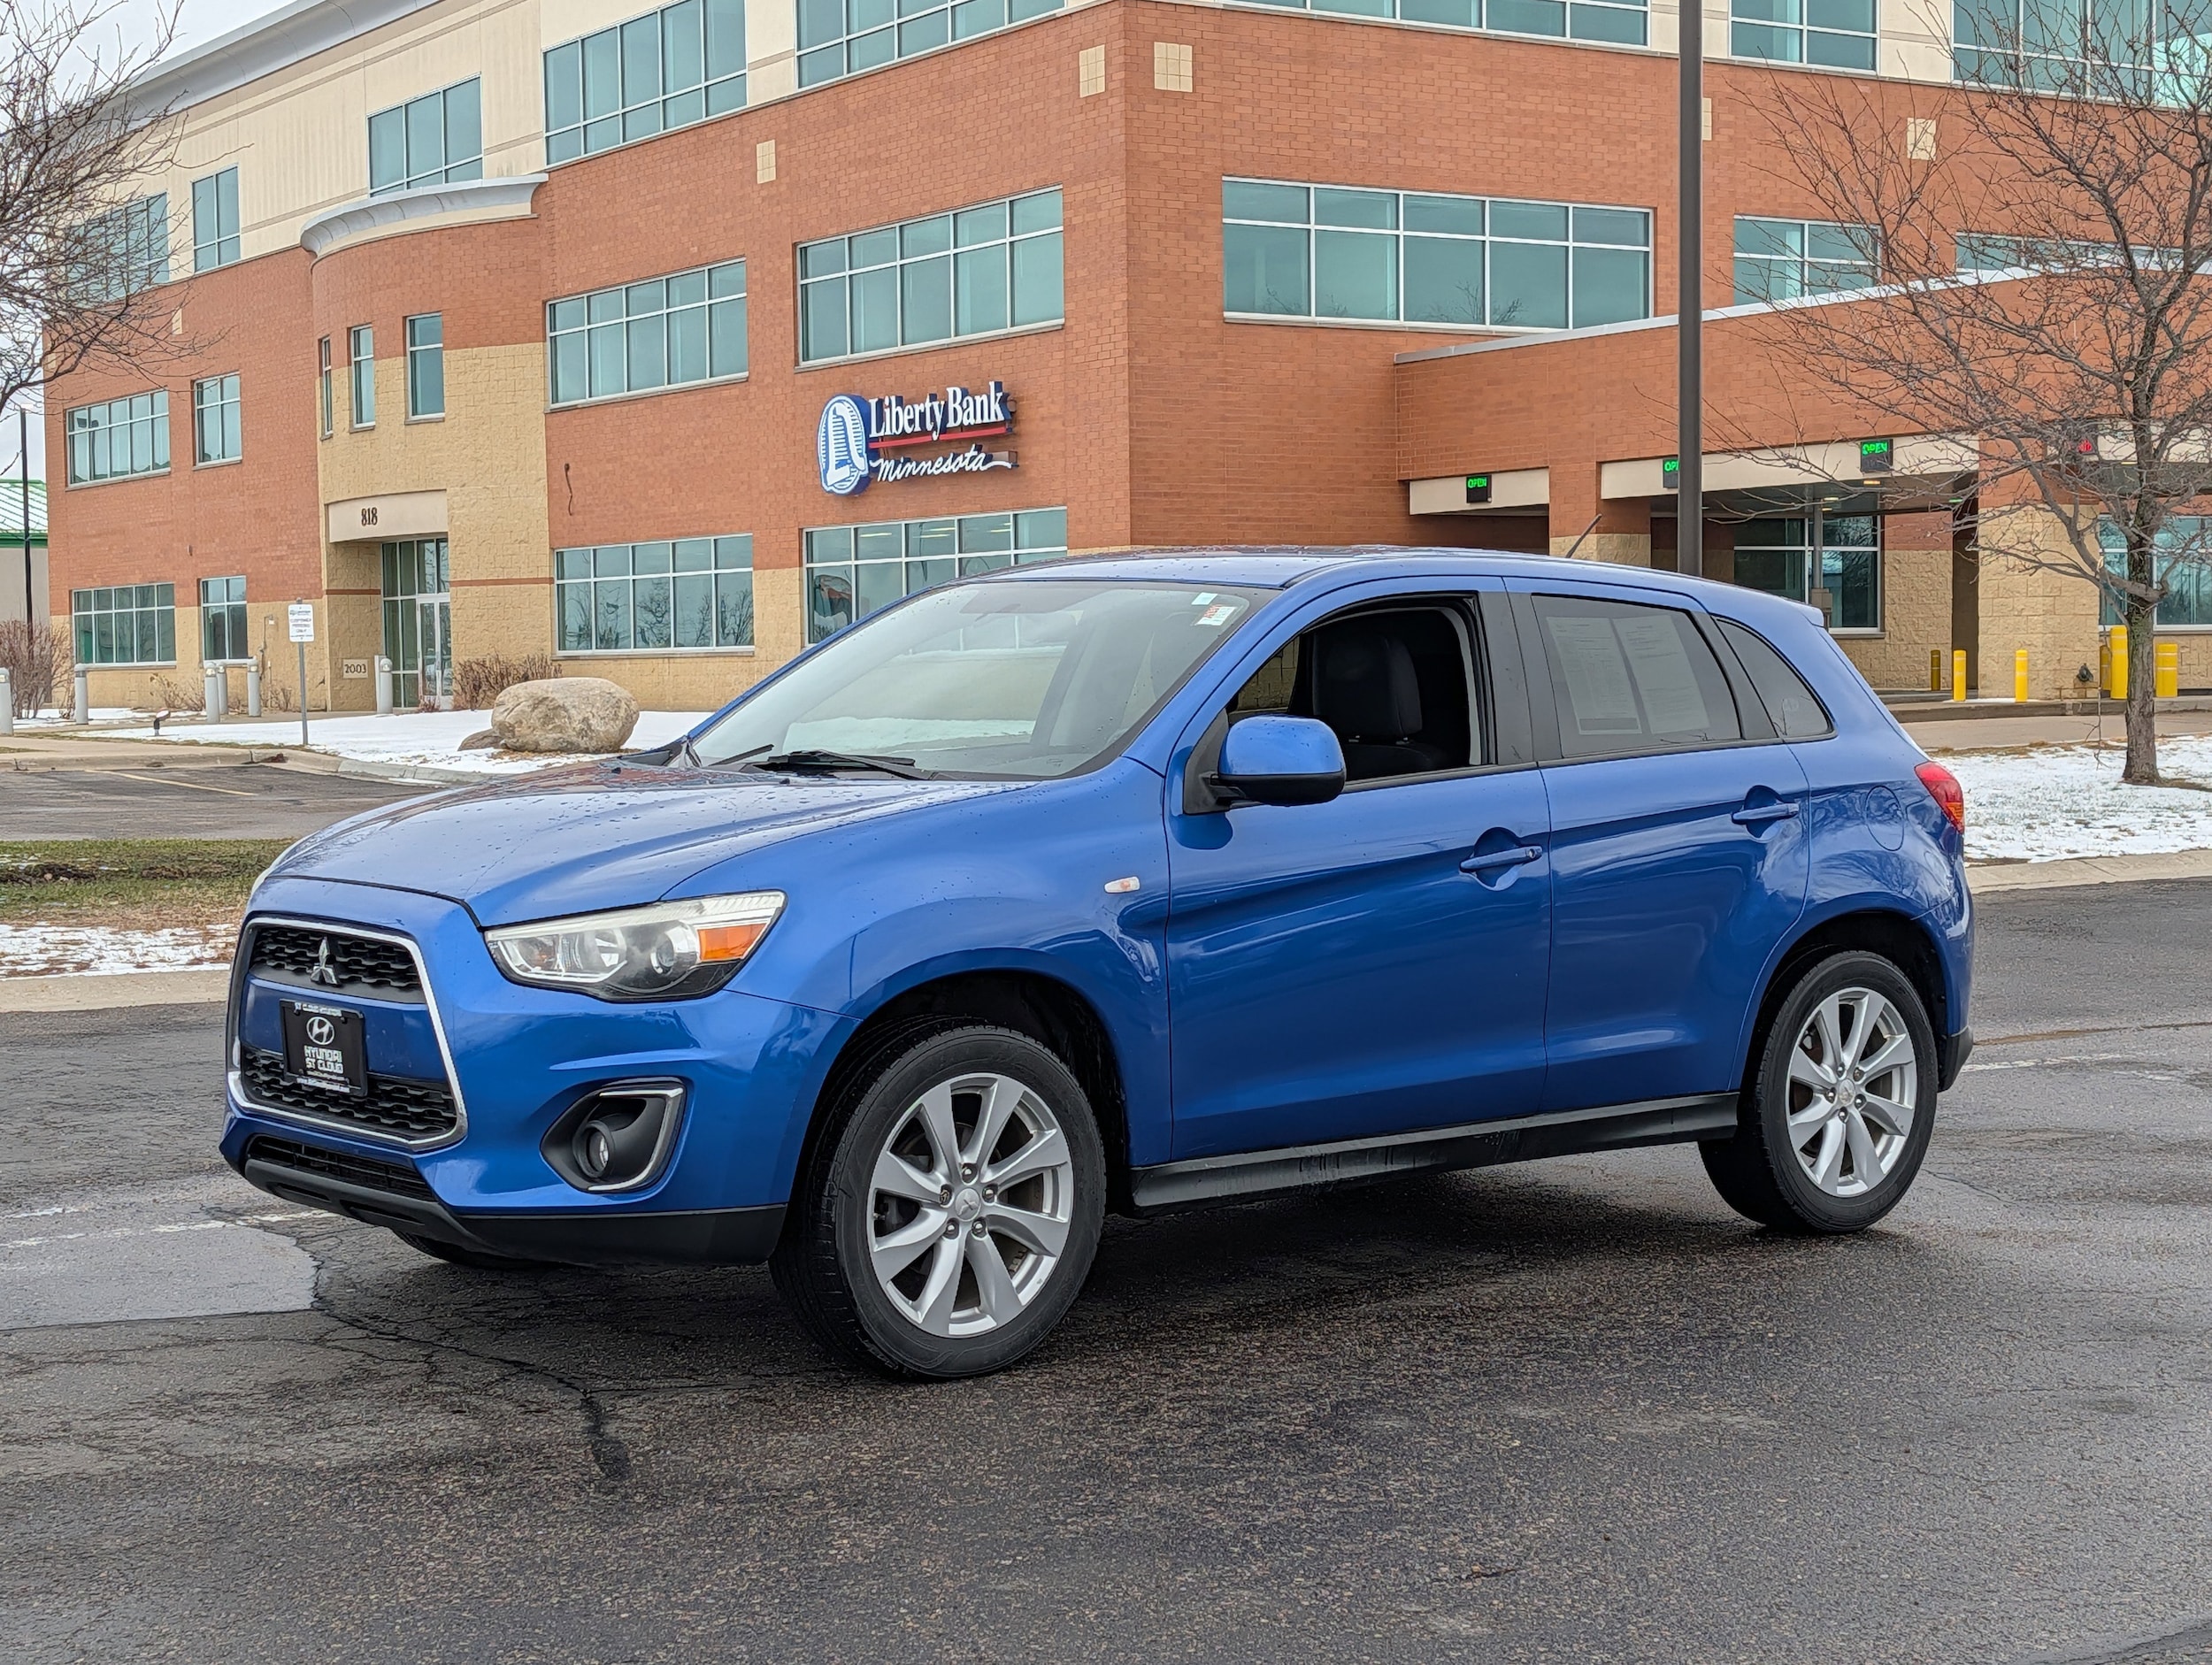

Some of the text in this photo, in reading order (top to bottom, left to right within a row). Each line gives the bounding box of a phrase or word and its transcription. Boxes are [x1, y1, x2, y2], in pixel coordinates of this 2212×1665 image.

[869, 380, 1006, 441] Liberty Bank
[1862, 442, 1888, 455] OPEN
[870, 443, 1012, 482] Minnesota
[1468, 478, 1487, 488] OPEN
[361, 508, 378, 526] 818
[344, 664, 367, 674] 2003
[304, 1045, 342, 1063] HYUNDAI
[317, 1059, 344, 1074] CLOUD
